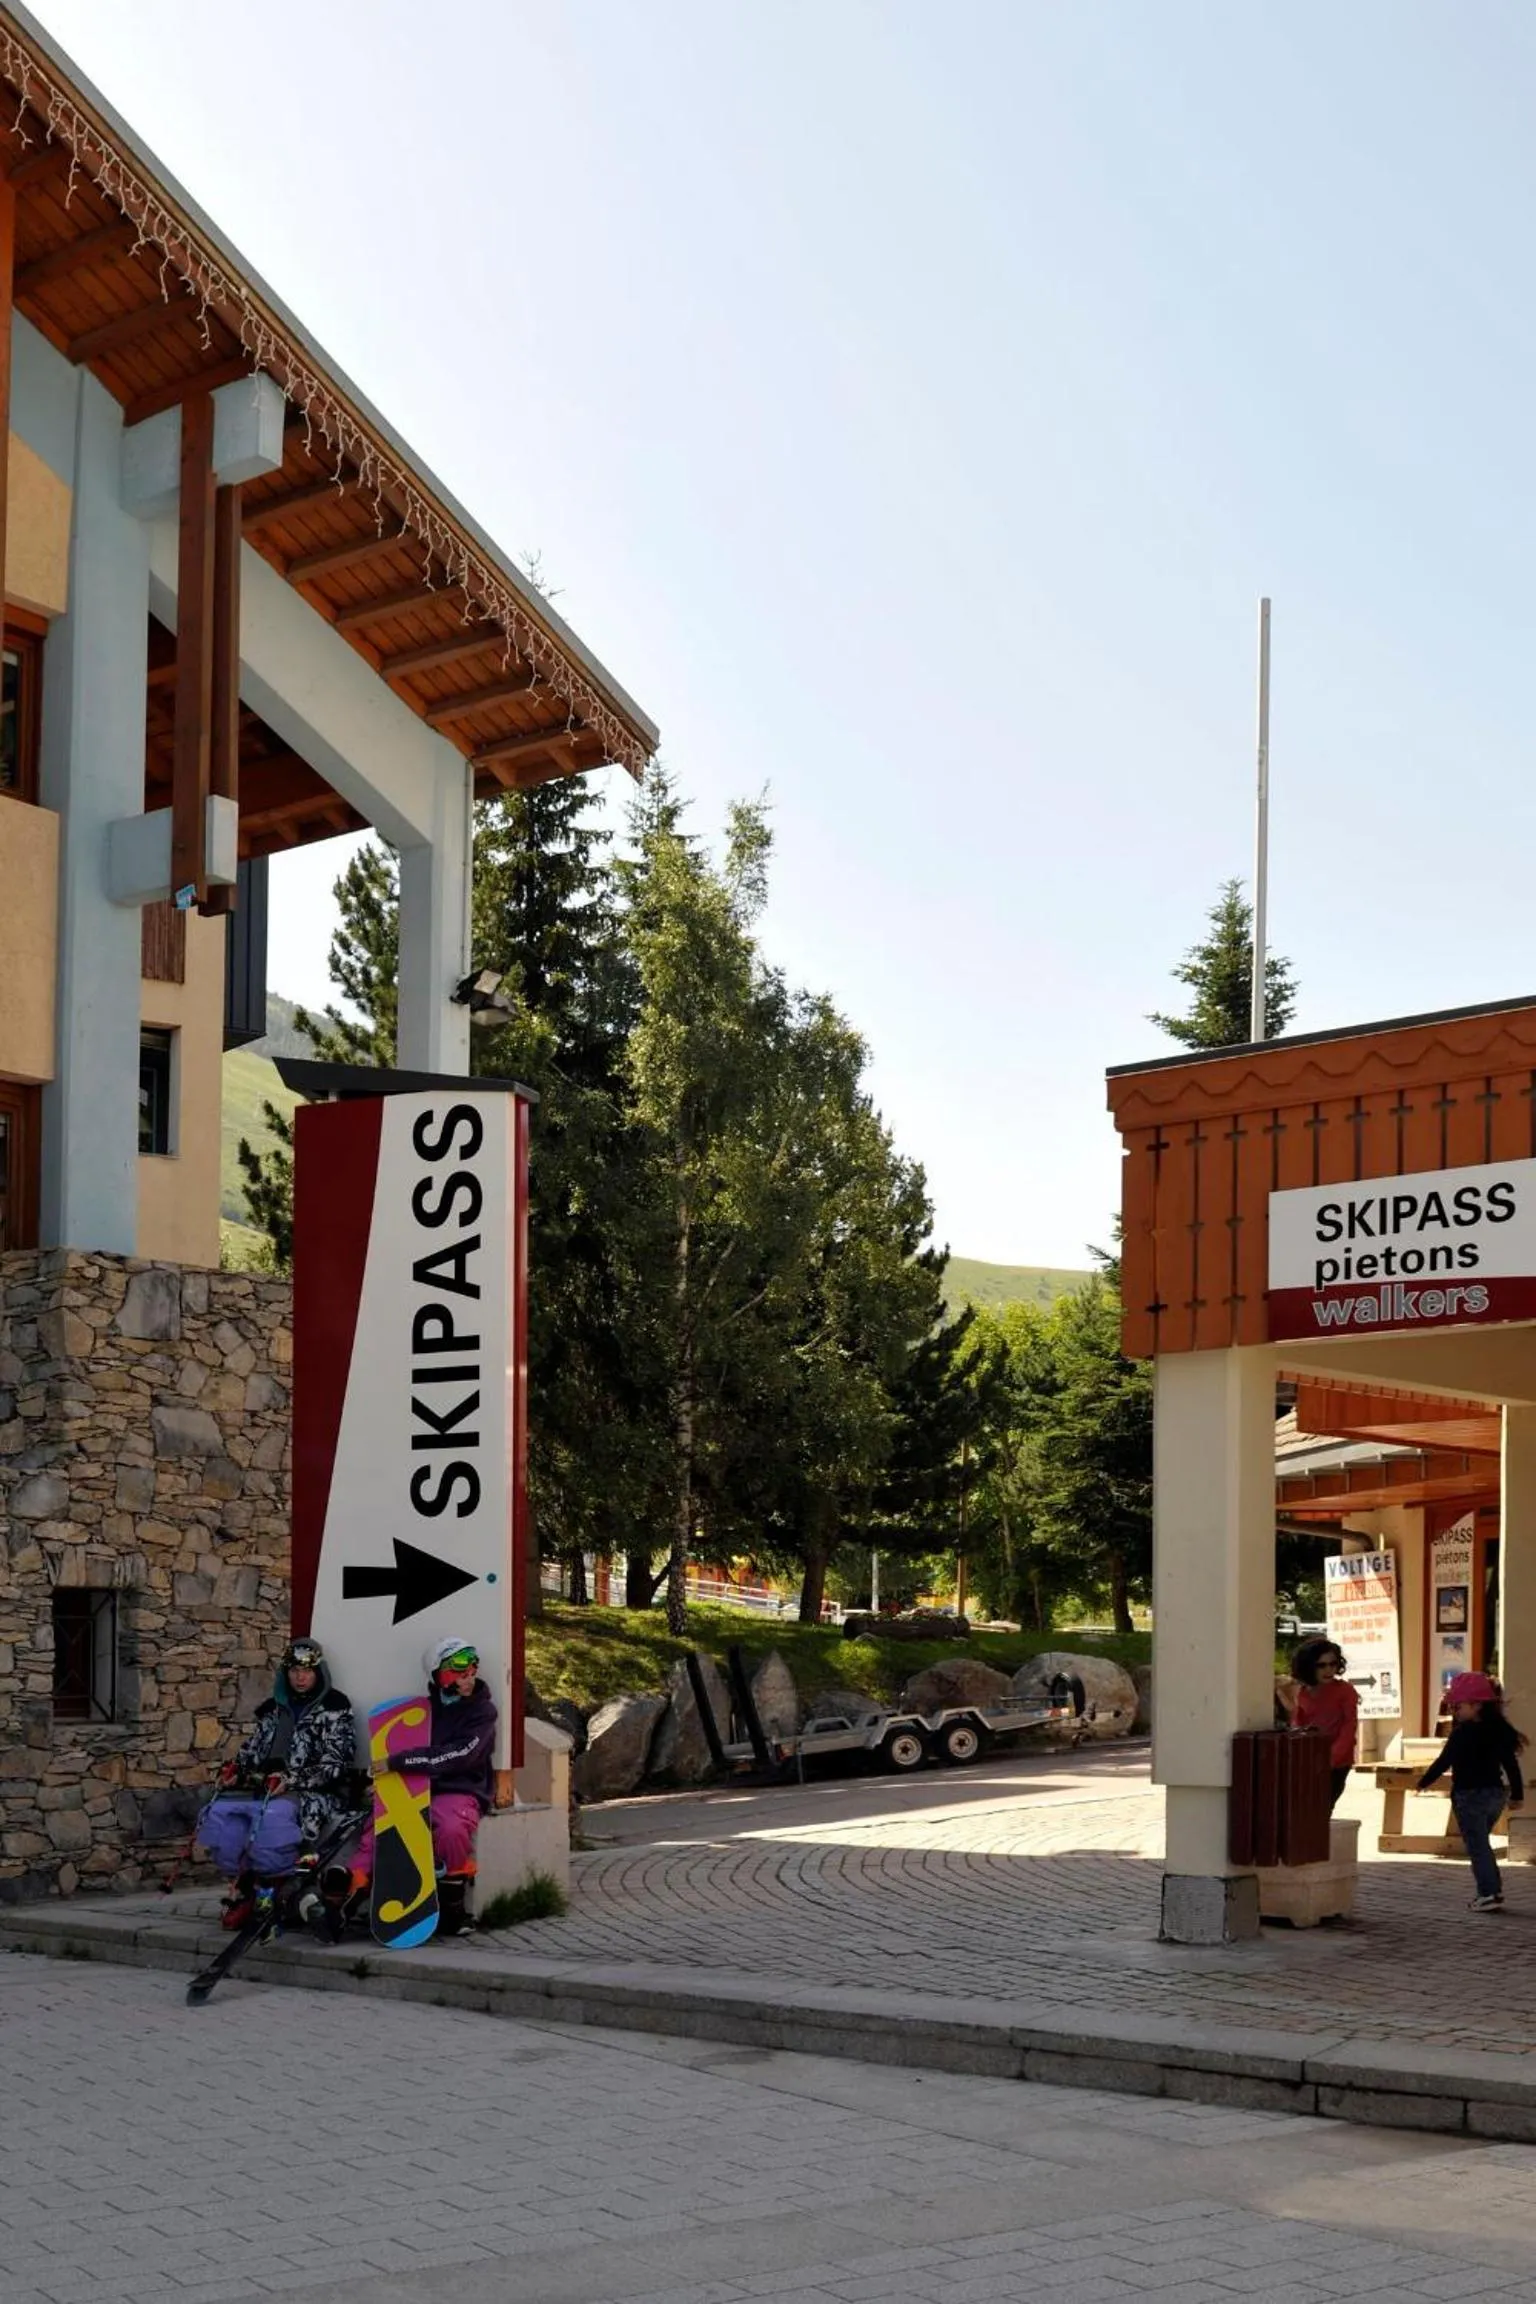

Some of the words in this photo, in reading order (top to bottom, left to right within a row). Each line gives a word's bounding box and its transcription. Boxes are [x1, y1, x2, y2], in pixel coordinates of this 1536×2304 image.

[1315, 1182, 1516, 1242] SKIPASS
[1314, 1243, 1480, 1292] pietons
[410, 1103, 484, 1518] SKIPASS
[1312, 1284, 1489, 1327] walkers
[1433, 1527, 1473, 1546] KIPASS
[1328, 1555, 1391, 1577] VOLTIGE
